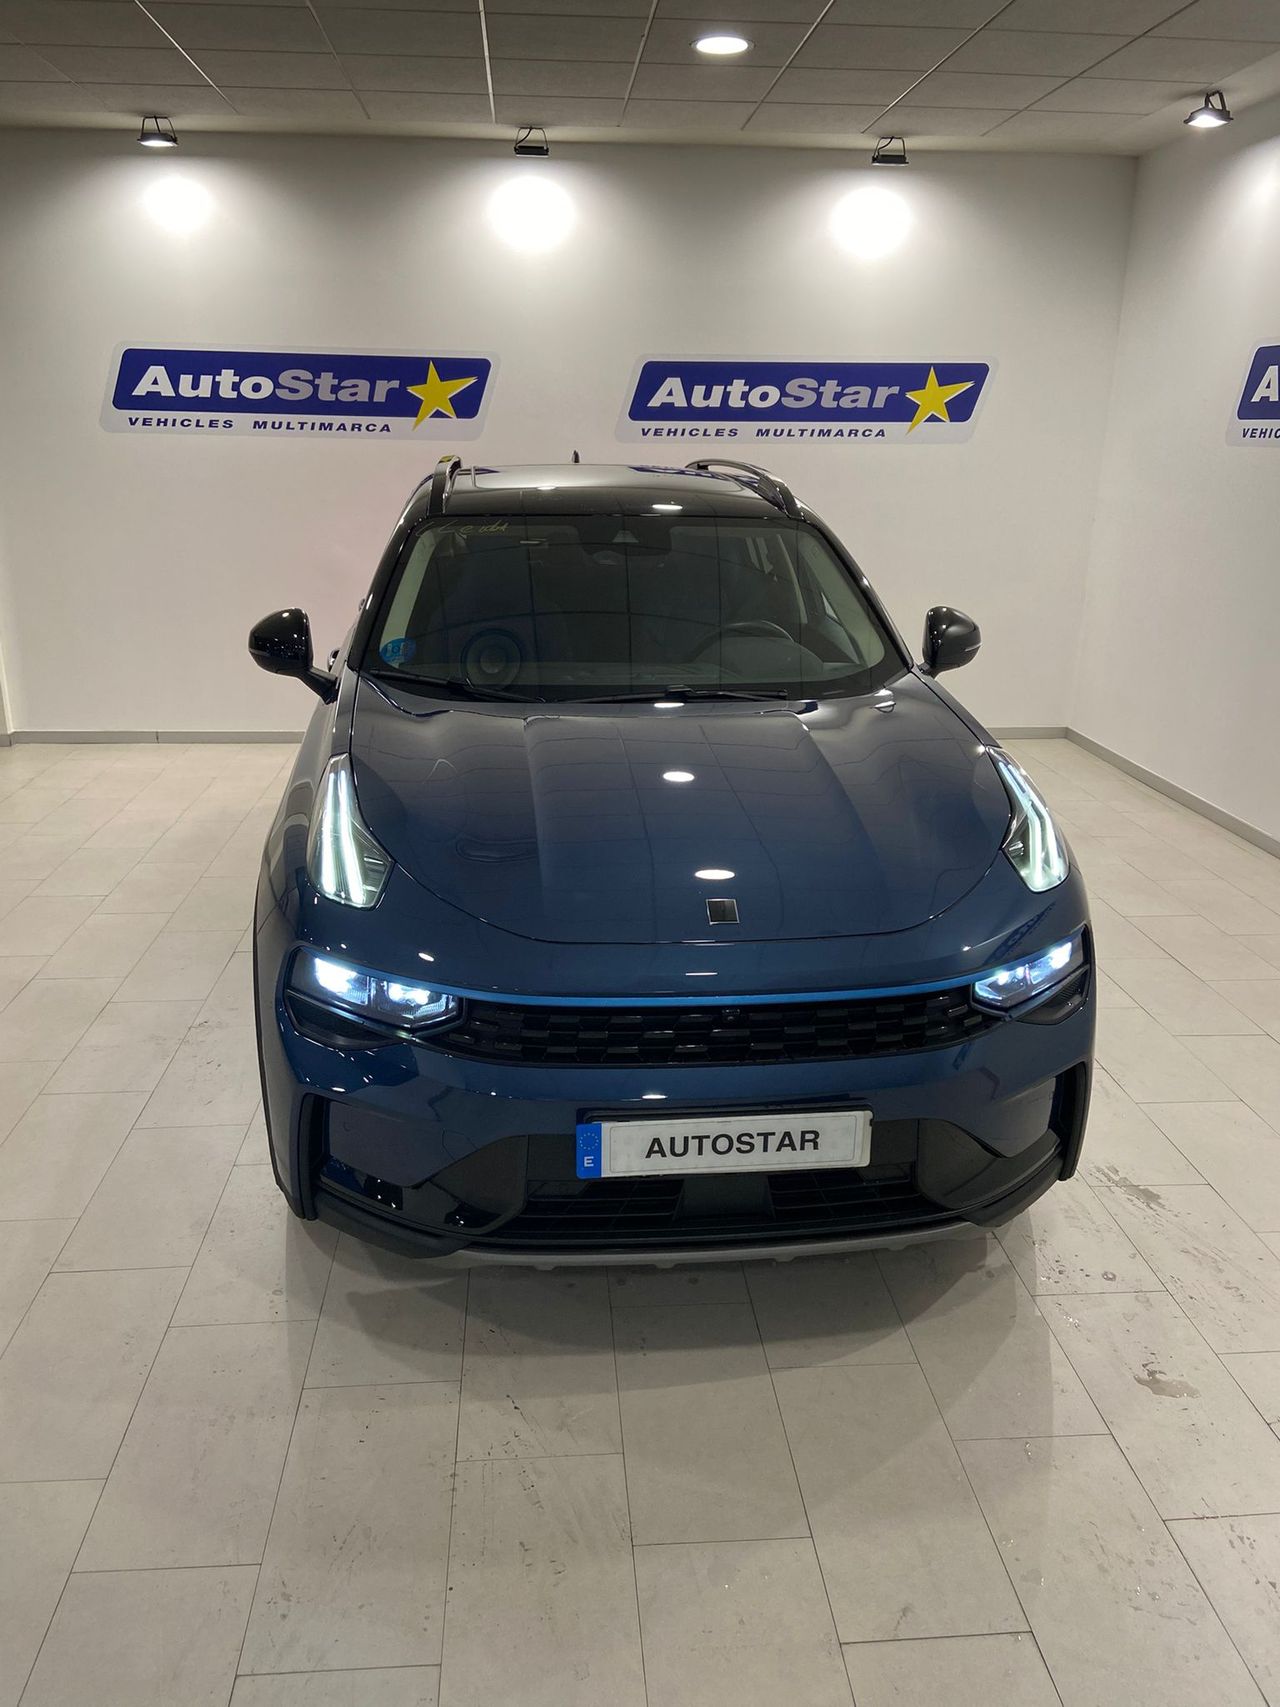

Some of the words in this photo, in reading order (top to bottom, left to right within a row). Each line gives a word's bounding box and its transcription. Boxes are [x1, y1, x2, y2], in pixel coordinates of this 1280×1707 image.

[132, 365, 400, 403] AutoStar
[647, 377, 900, 409] AutoStar
[128, 416, 234, 429] VEHICLES
[252, 419, 392, 433] MULTIMARCA
[640, 427, 739, 438] VEHICLES
[755, 428, 886, 438] MULTIMARCA
[645, 1130, 820, 1159] AUTOSTAR
[583, 1156, 594, 1167] E
